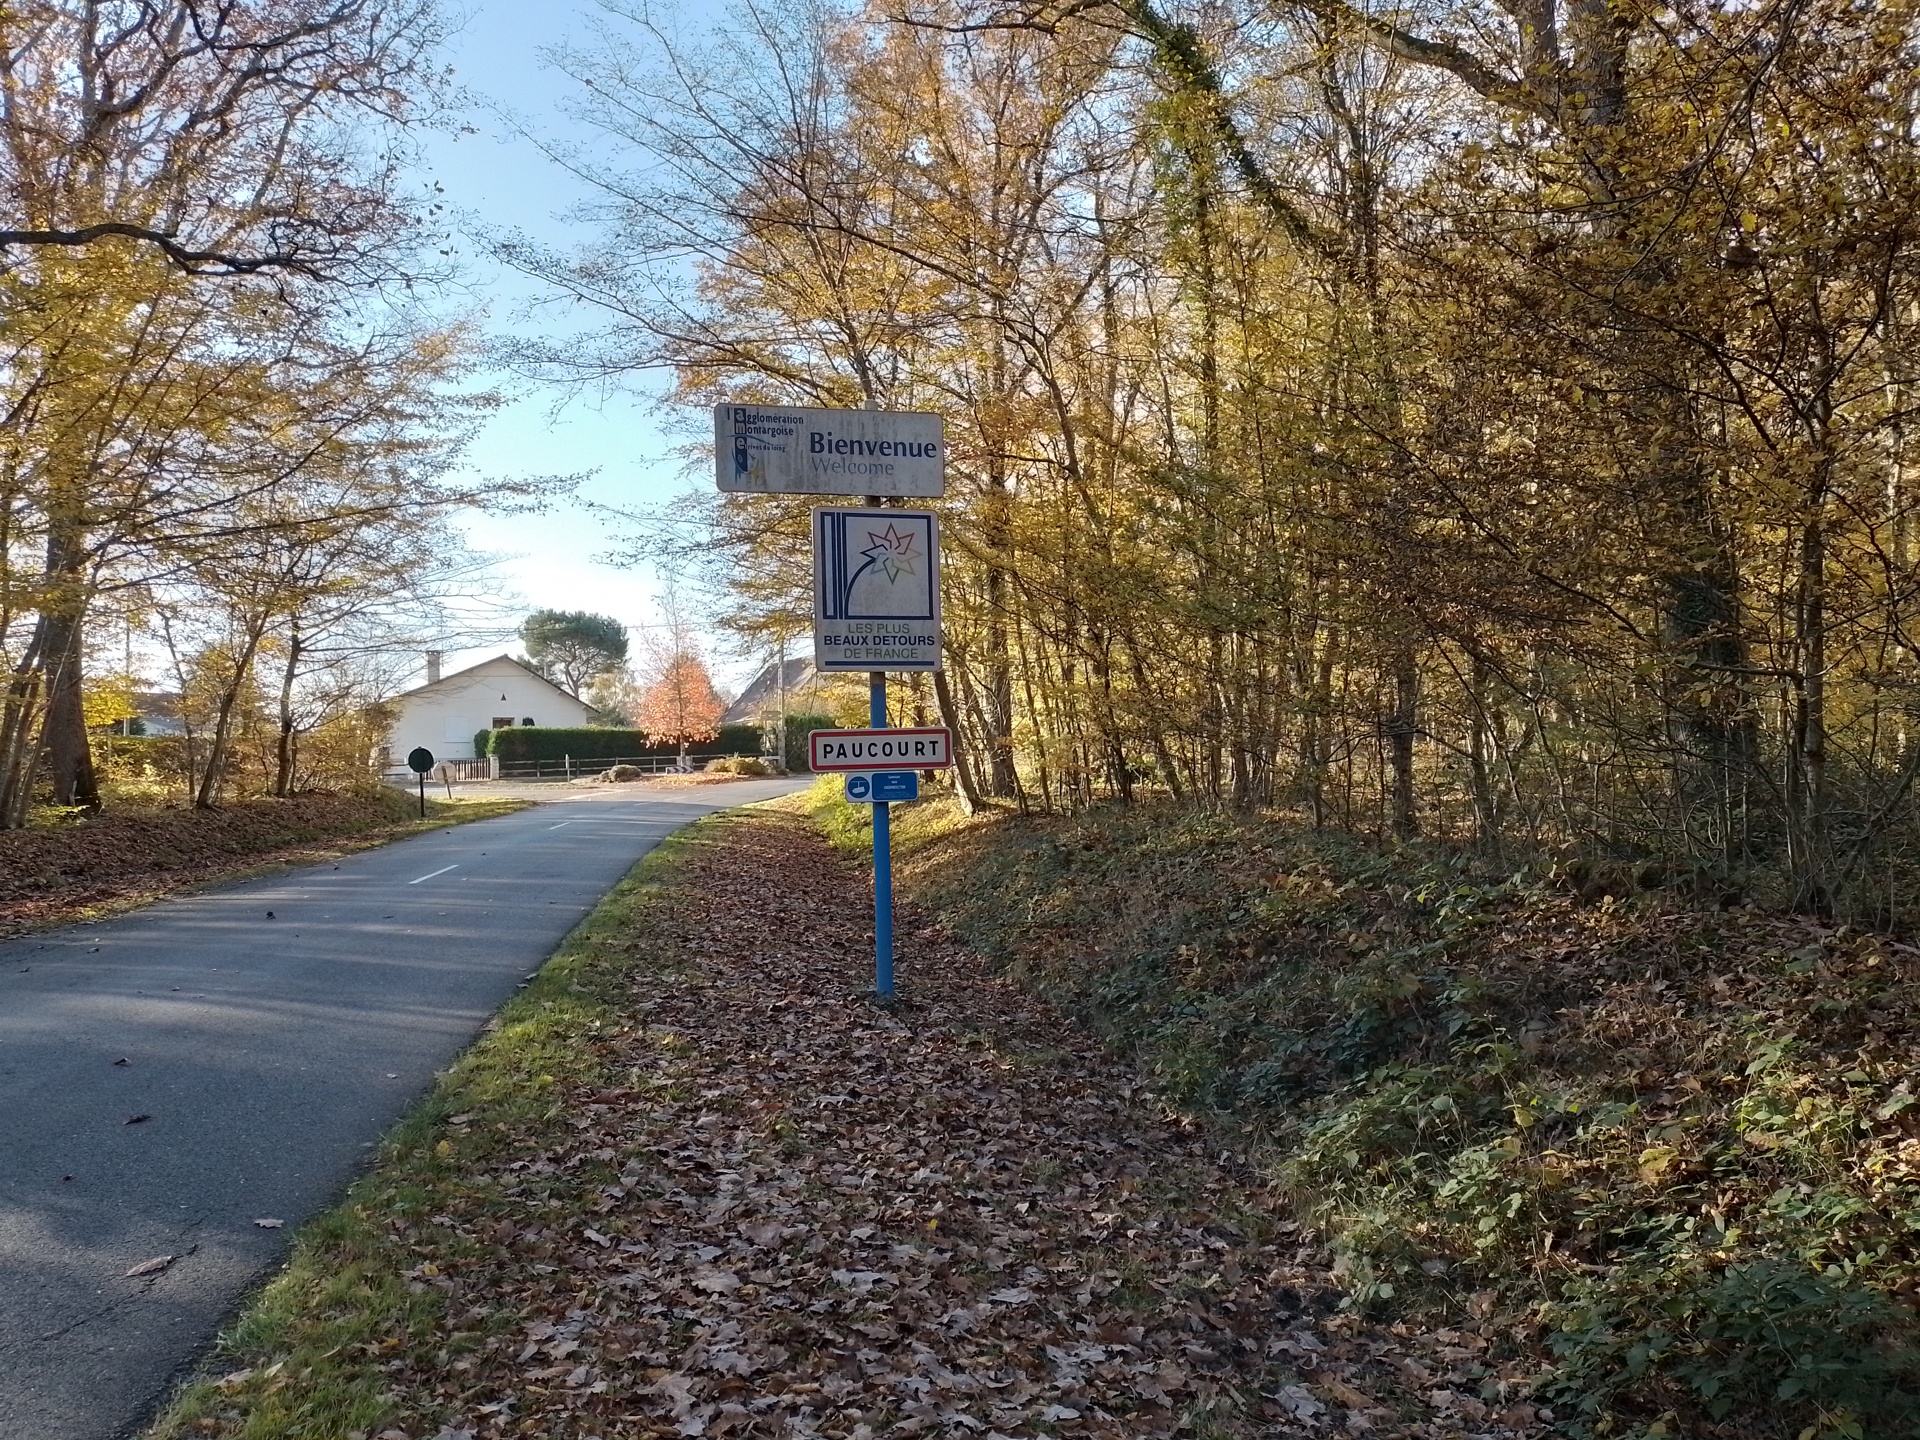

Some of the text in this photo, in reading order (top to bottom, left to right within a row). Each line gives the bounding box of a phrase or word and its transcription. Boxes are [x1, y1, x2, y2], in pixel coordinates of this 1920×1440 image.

[810, 431, 937, 458] Bienvenue
[811, 457, 894, 475] Welcome
[848, 623, 910, 634] LES PLUS
[824, 635, 935, 646] BEAUX DETOURS
[844, 648, 918, 659] DE FRANCE
[823, 740, 938, 759] PAUCOURT
